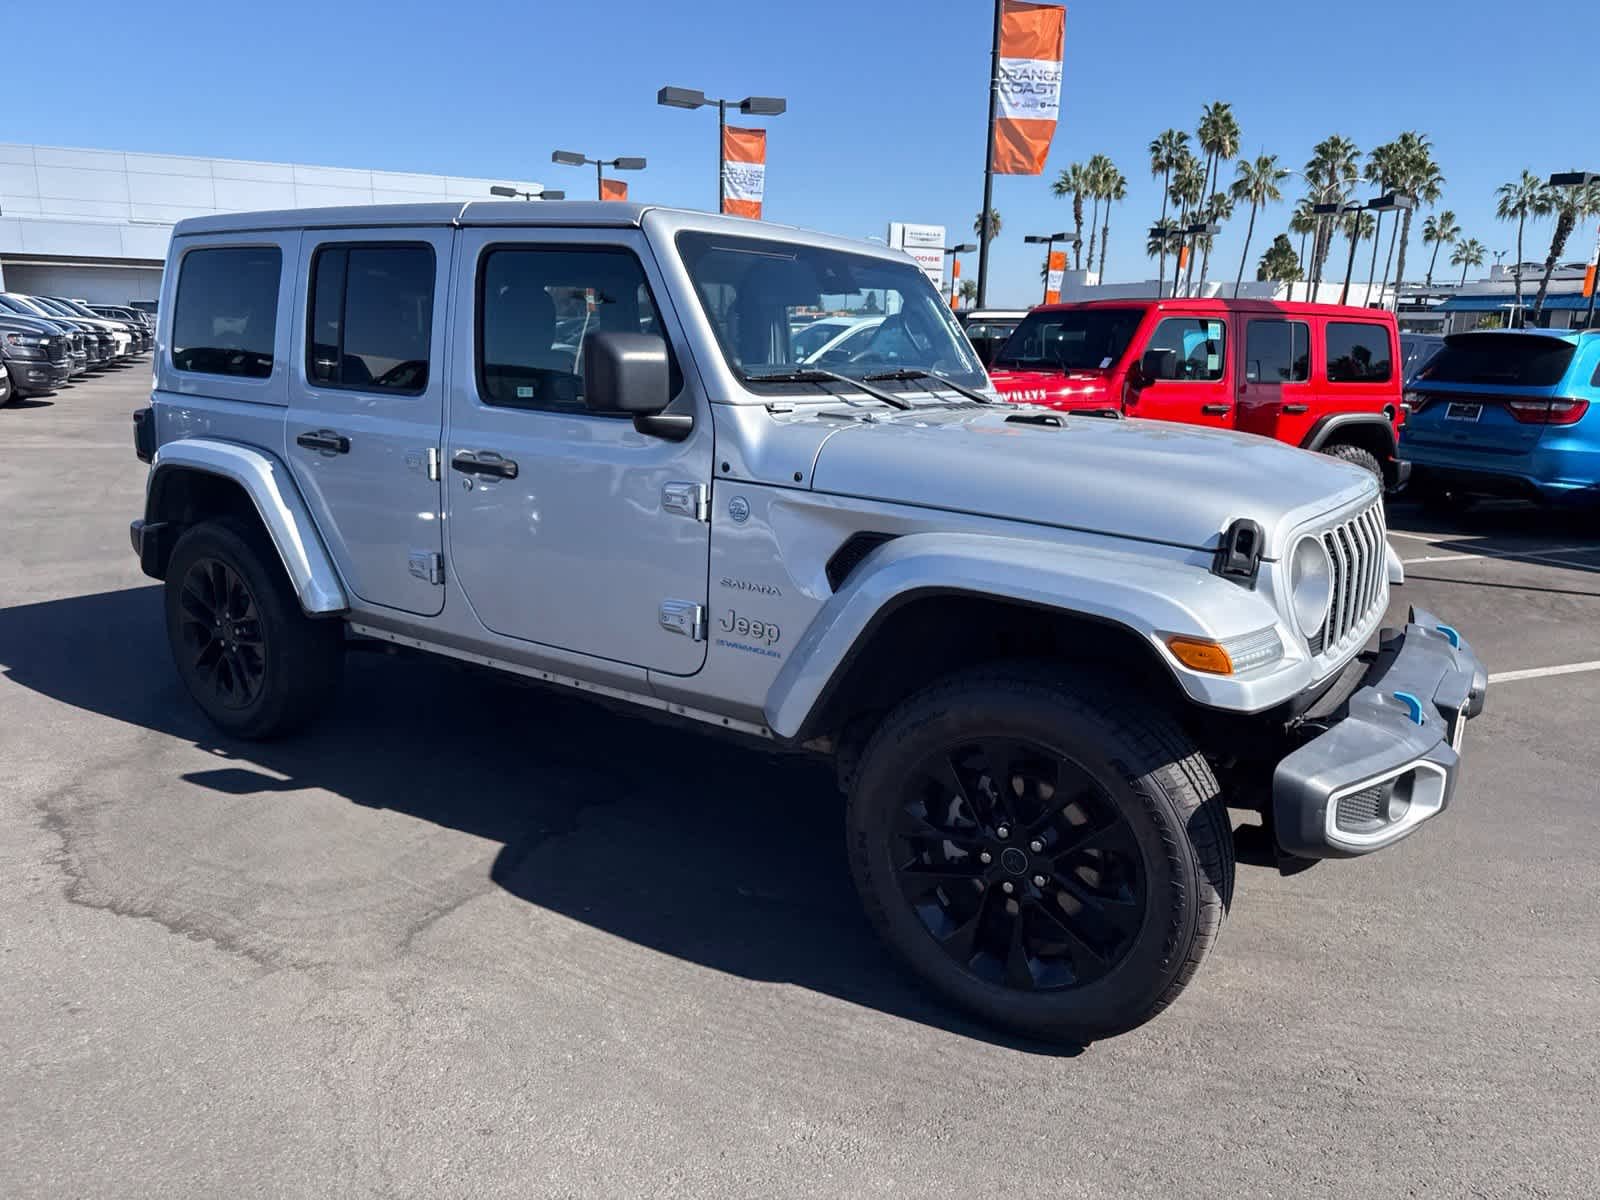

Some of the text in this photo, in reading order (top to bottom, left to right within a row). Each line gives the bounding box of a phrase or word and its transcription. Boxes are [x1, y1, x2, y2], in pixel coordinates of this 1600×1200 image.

[1000, 81, 1057, 95] COAST
[719, 577, 783, 597] SAHARA
[719, 608, 781, 646] Jeep
